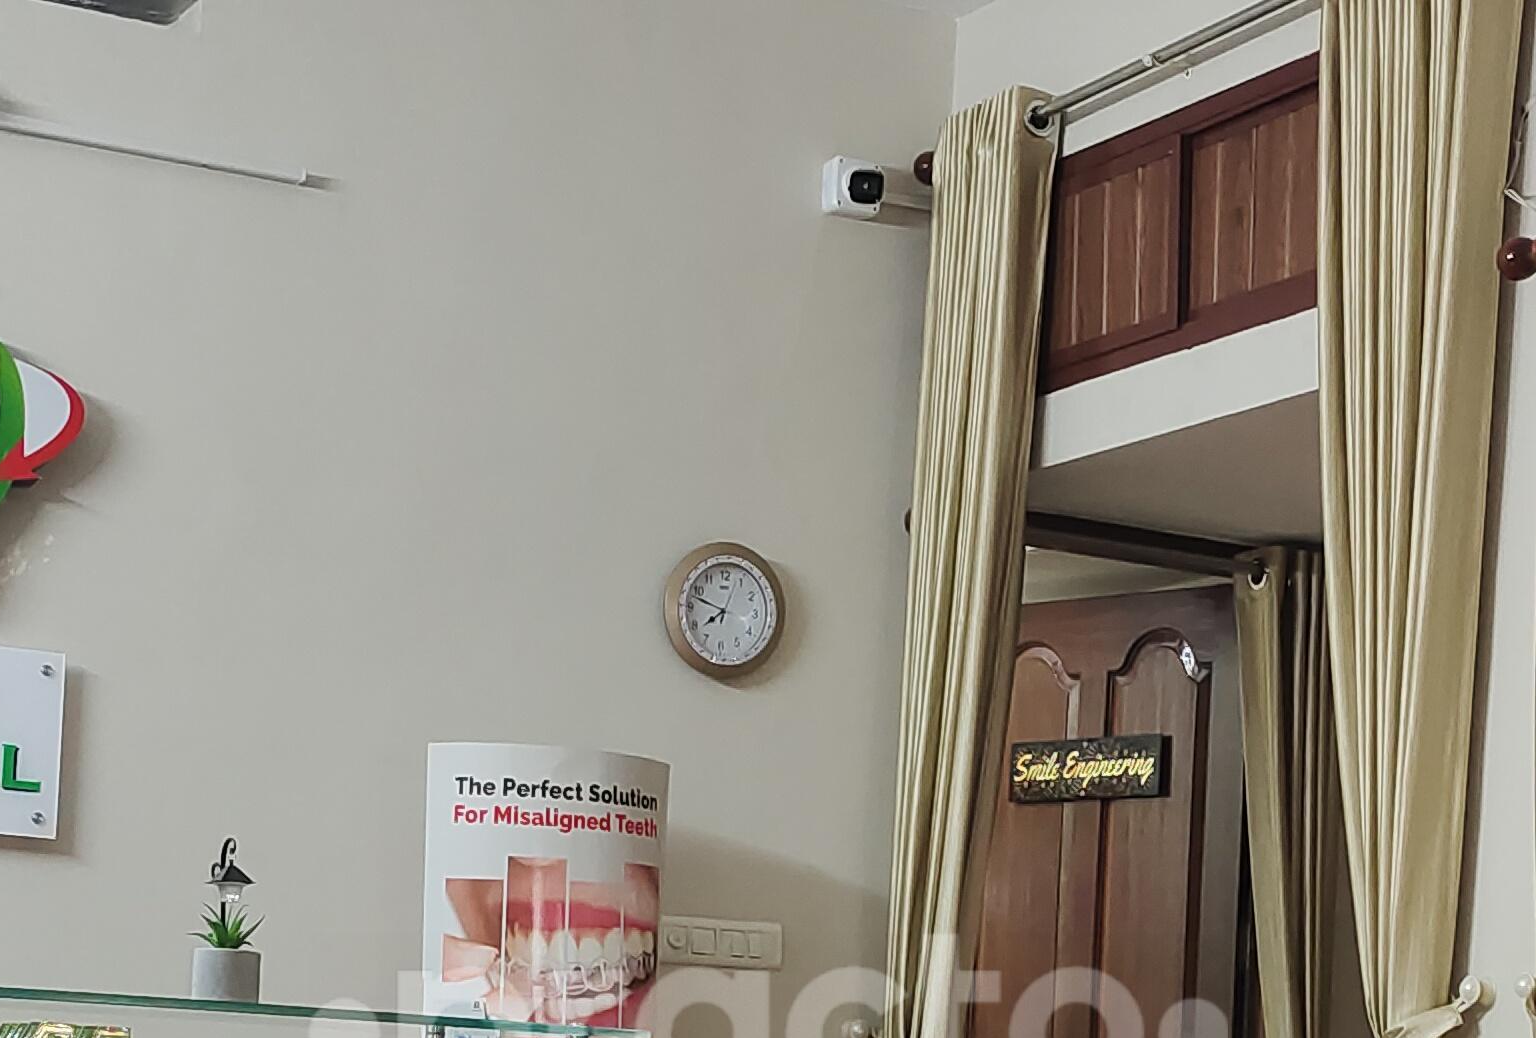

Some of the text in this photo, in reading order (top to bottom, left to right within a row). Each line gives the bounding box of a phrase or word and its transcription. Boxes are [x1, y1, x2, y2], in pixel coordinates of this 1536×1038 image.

[720, 570, 731, 582] 12
[1013, 750, 1155, 789] Smile Engineering
[454, 776, 658, 812] The Perfect Solution
[453, 804, 658, 839] For Misaligned Teeth
